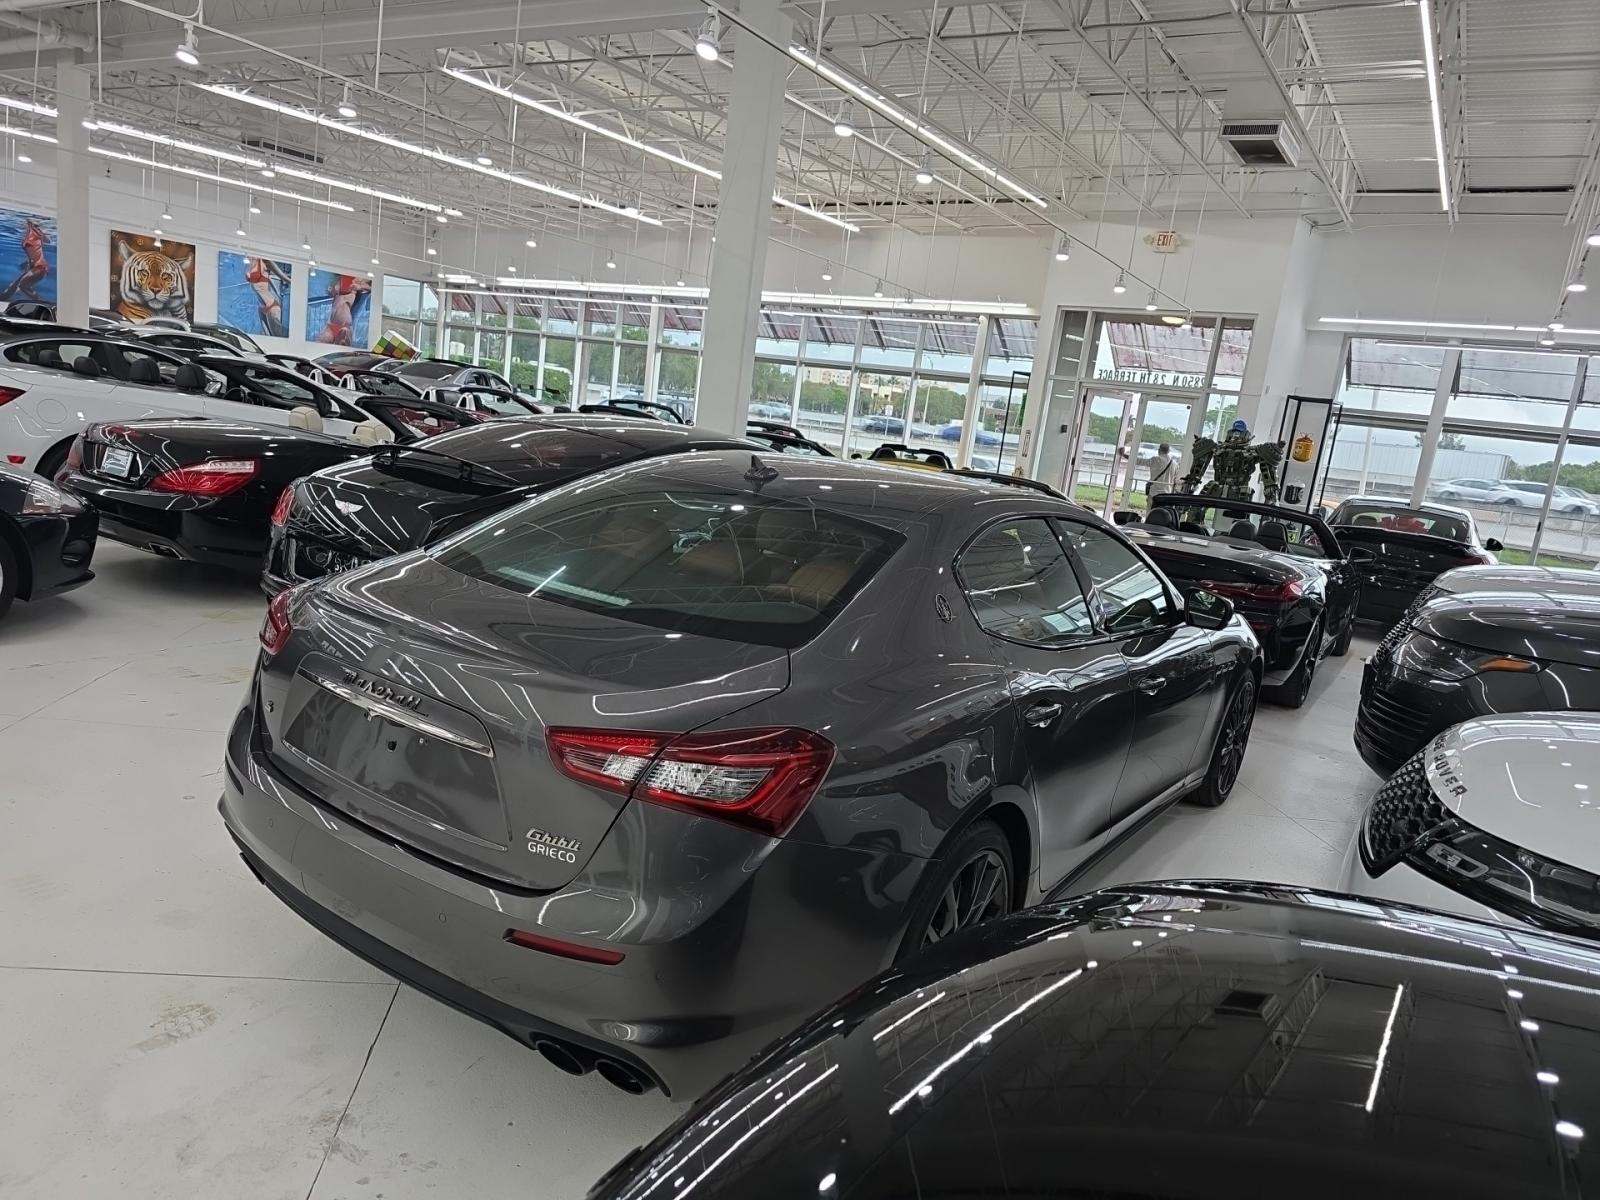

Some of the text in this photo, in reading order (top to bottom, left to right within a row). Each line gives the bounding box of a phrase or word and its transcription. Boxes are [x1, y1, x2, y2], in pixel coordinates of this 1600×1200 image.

[1433, 752, 1468, 798] ROVER
[526, 827, 581, 851] Ghibli
[528, 841, 577, 864] GRIECO
